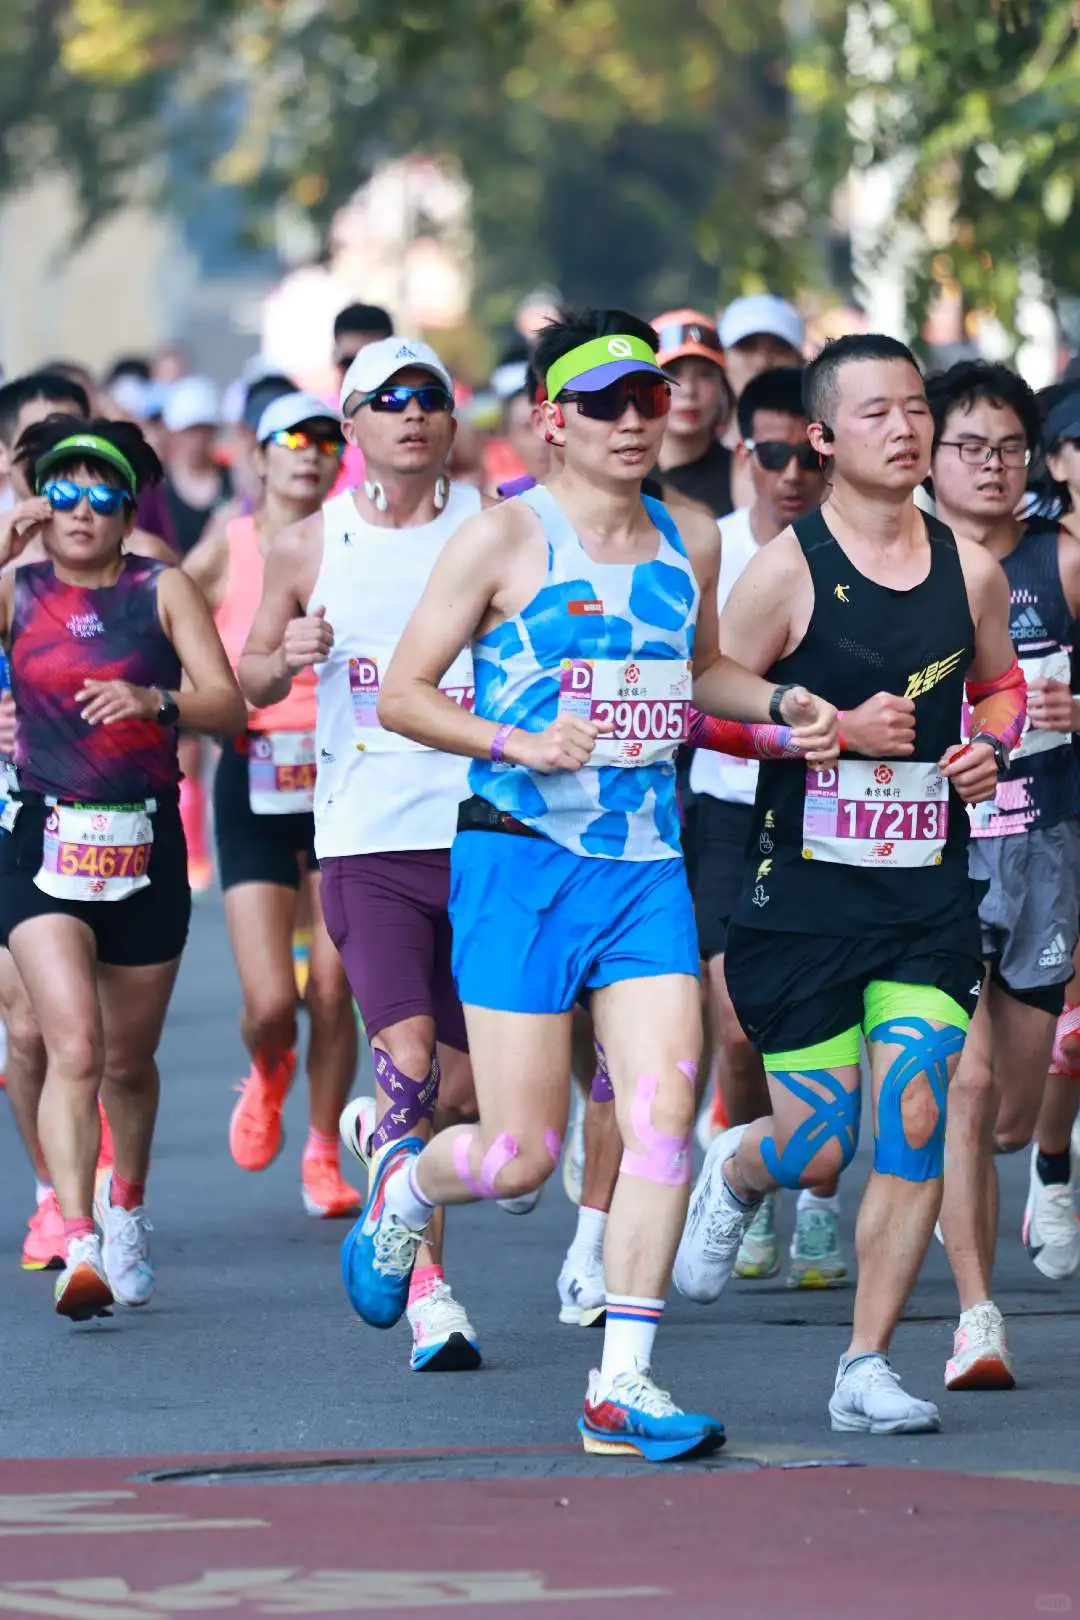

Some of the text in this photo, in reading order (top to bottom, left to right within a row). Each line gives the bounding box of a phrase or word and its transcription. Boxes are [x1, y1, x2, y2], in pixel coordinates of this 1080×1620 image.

[359, 663, 376, 685] D
[572, 667, 591, 689] D
[595, 702, 683, 739] 29005
[864, 787, 901, 798] 南京银行
[843, 802, 938, 839] 17213
[61, 844, 145, 878] 54676
